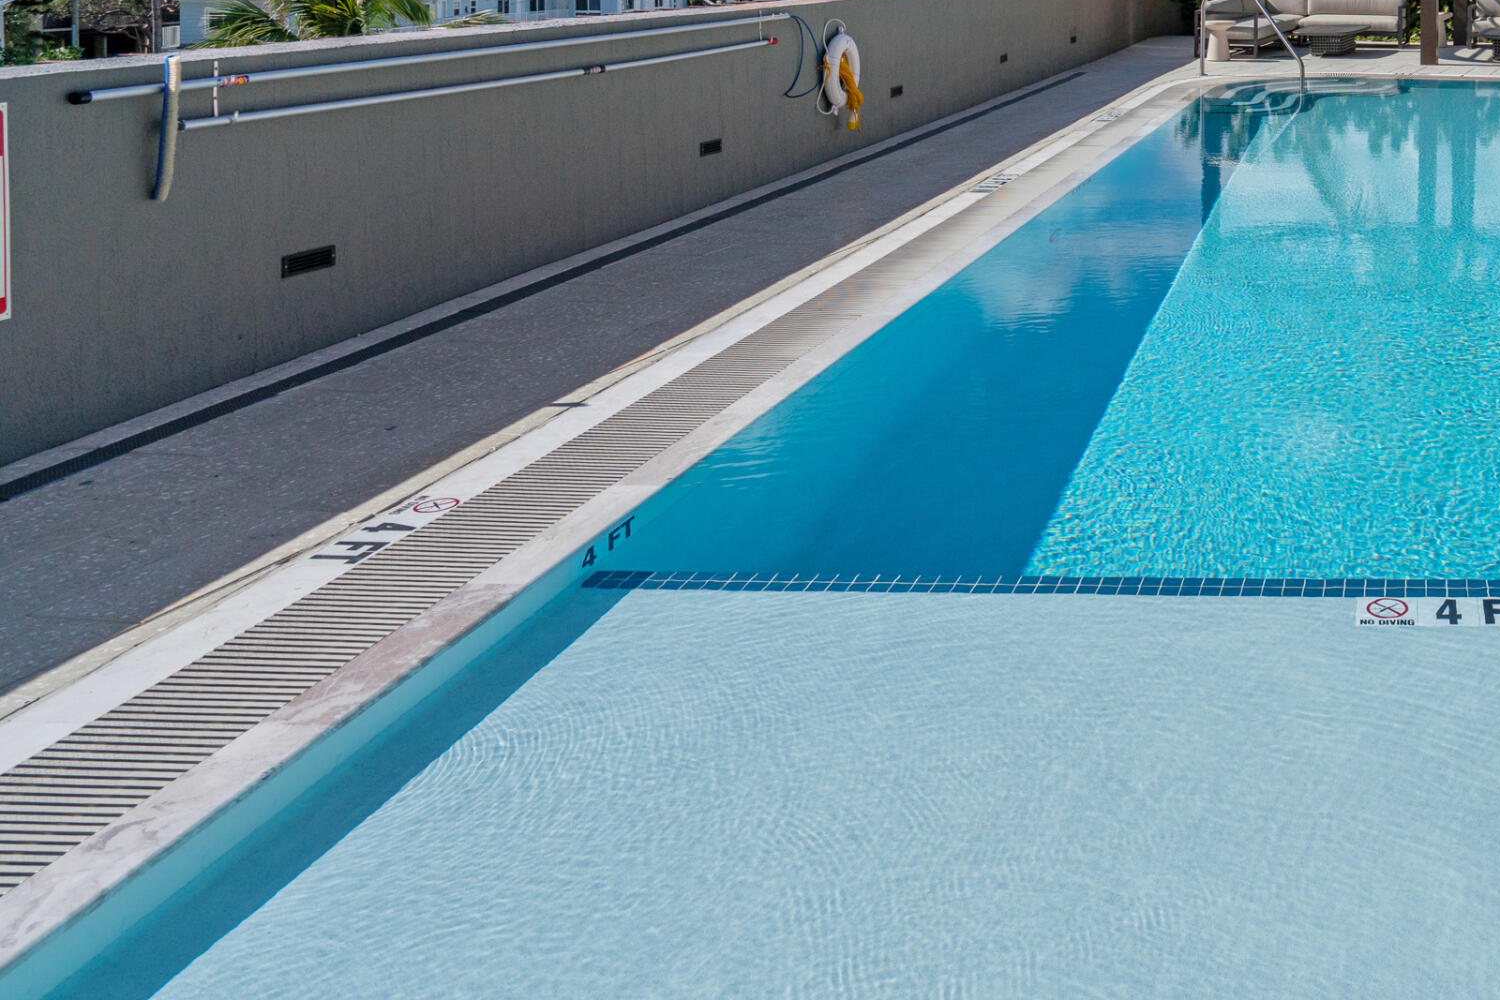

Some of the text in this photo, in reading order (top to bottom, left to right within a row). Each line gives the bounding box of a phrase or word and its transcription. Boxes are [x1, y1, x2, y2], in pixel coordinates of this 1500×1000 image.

[310, 522, 416, 564] 4 FT
[582, 516, 635, 568] 4 FT
[1436, 599, 1462, 624] 4
